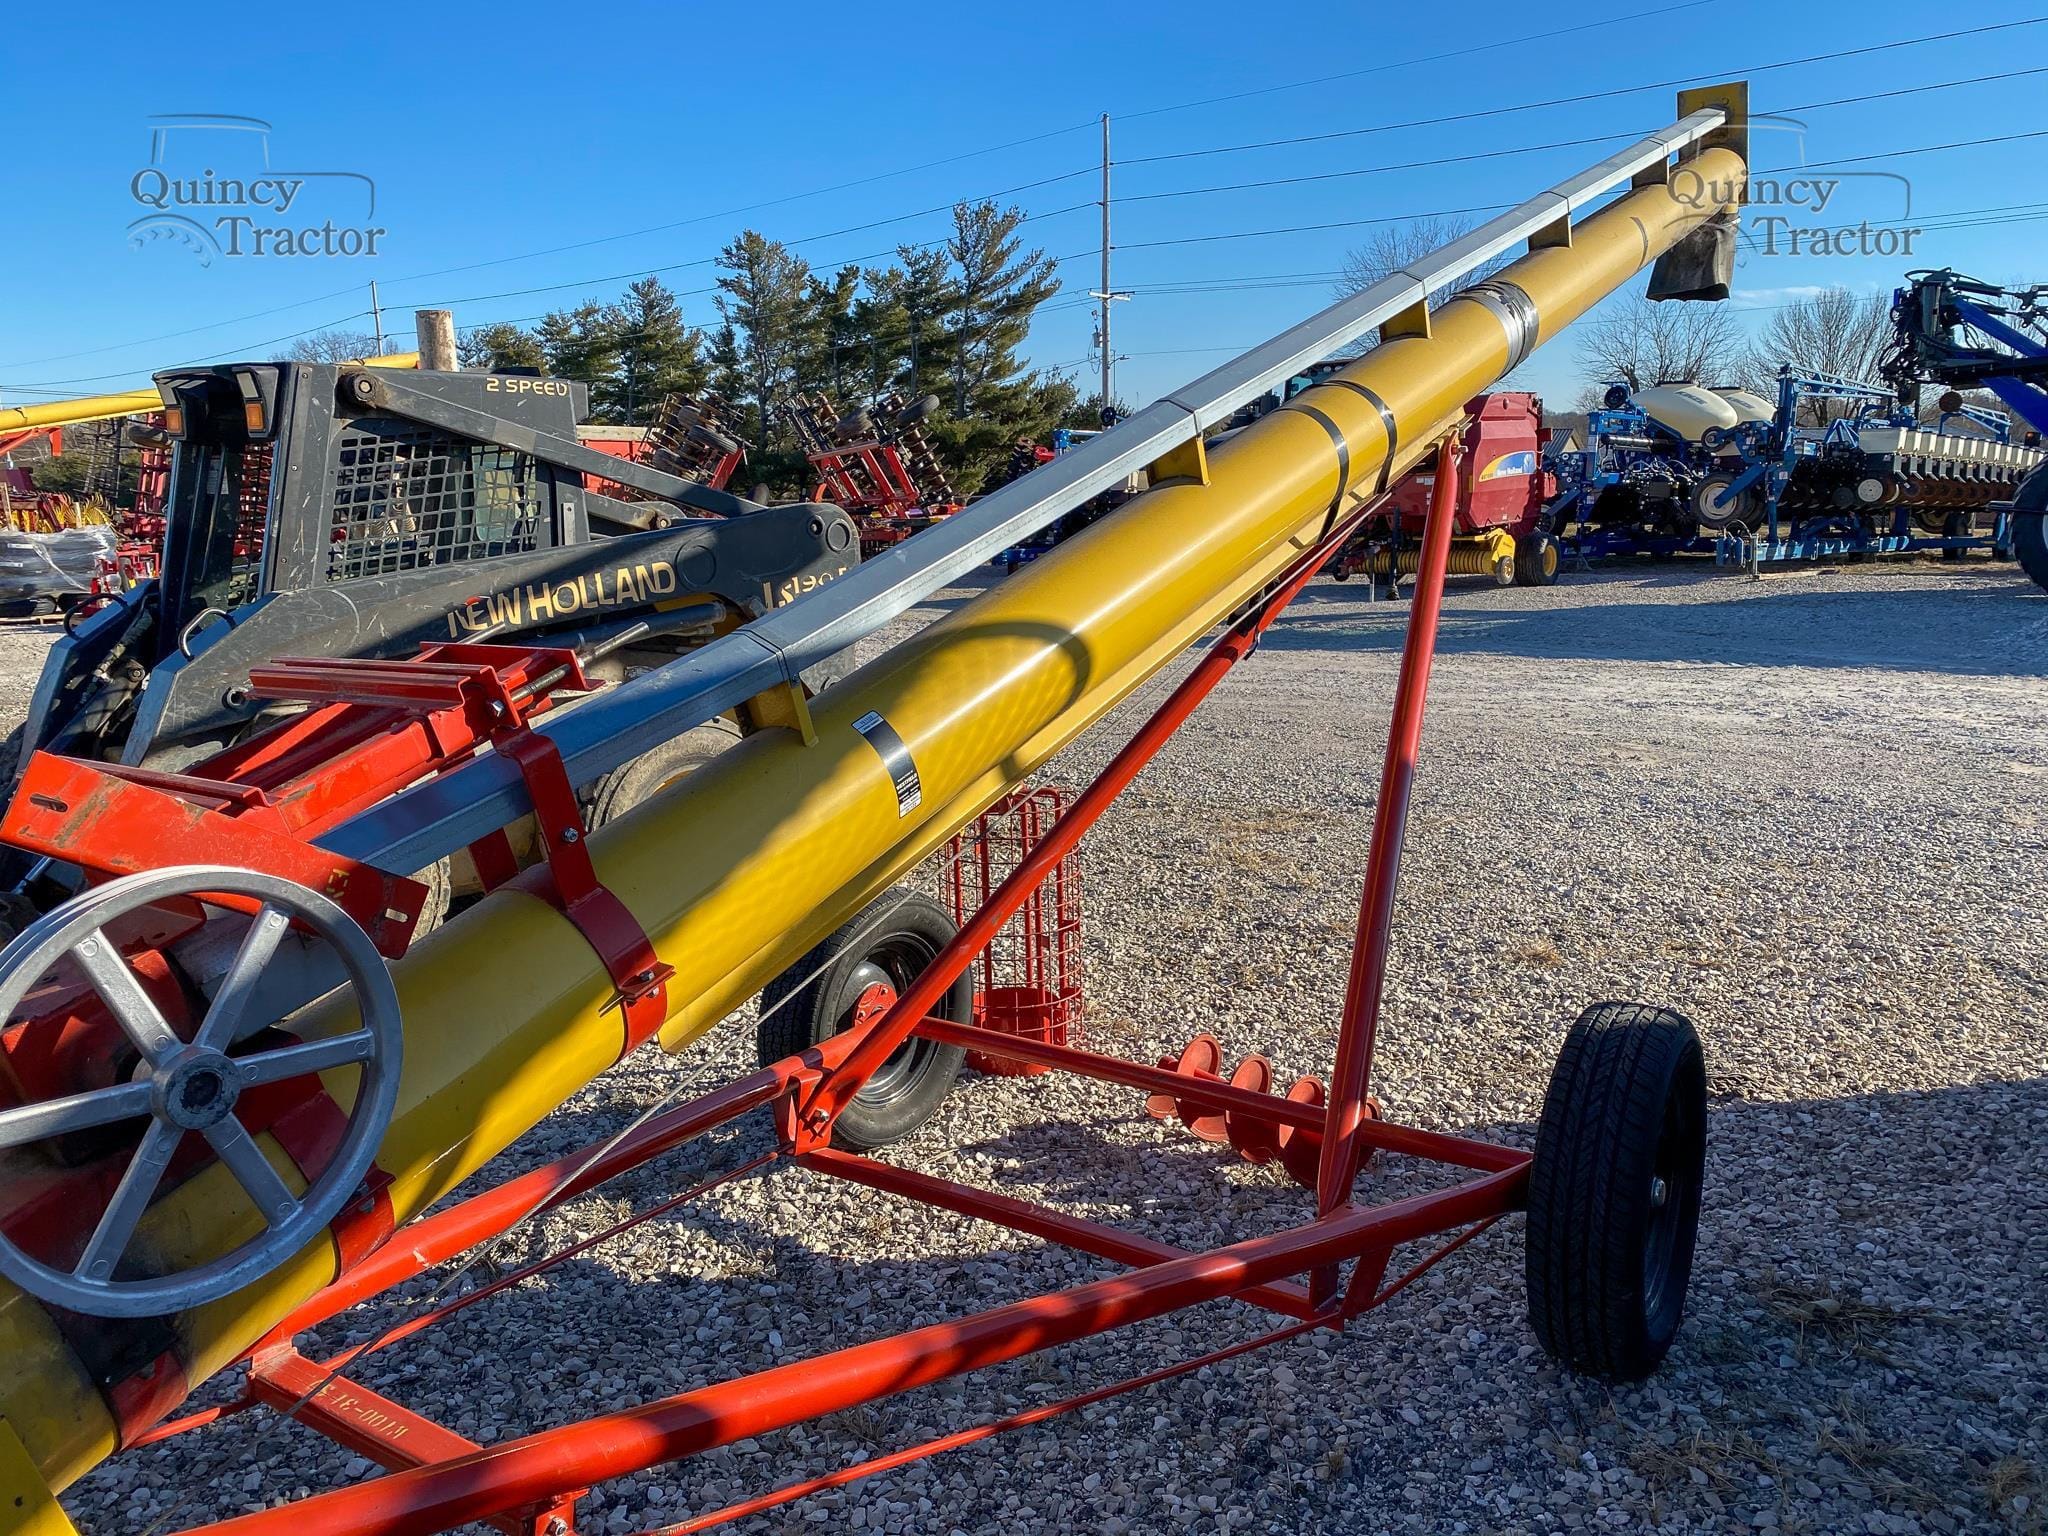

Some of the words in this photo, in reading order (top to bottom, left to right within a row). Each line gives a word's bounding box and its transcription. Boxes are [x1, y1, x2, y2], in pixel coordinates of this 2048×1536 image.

[486, 377, 500, 392] 2
[505, 379, 568, 397] SPEED
[447, 586, 522, 639] NEW
[526, 561, 677, 621] HOLLAND
